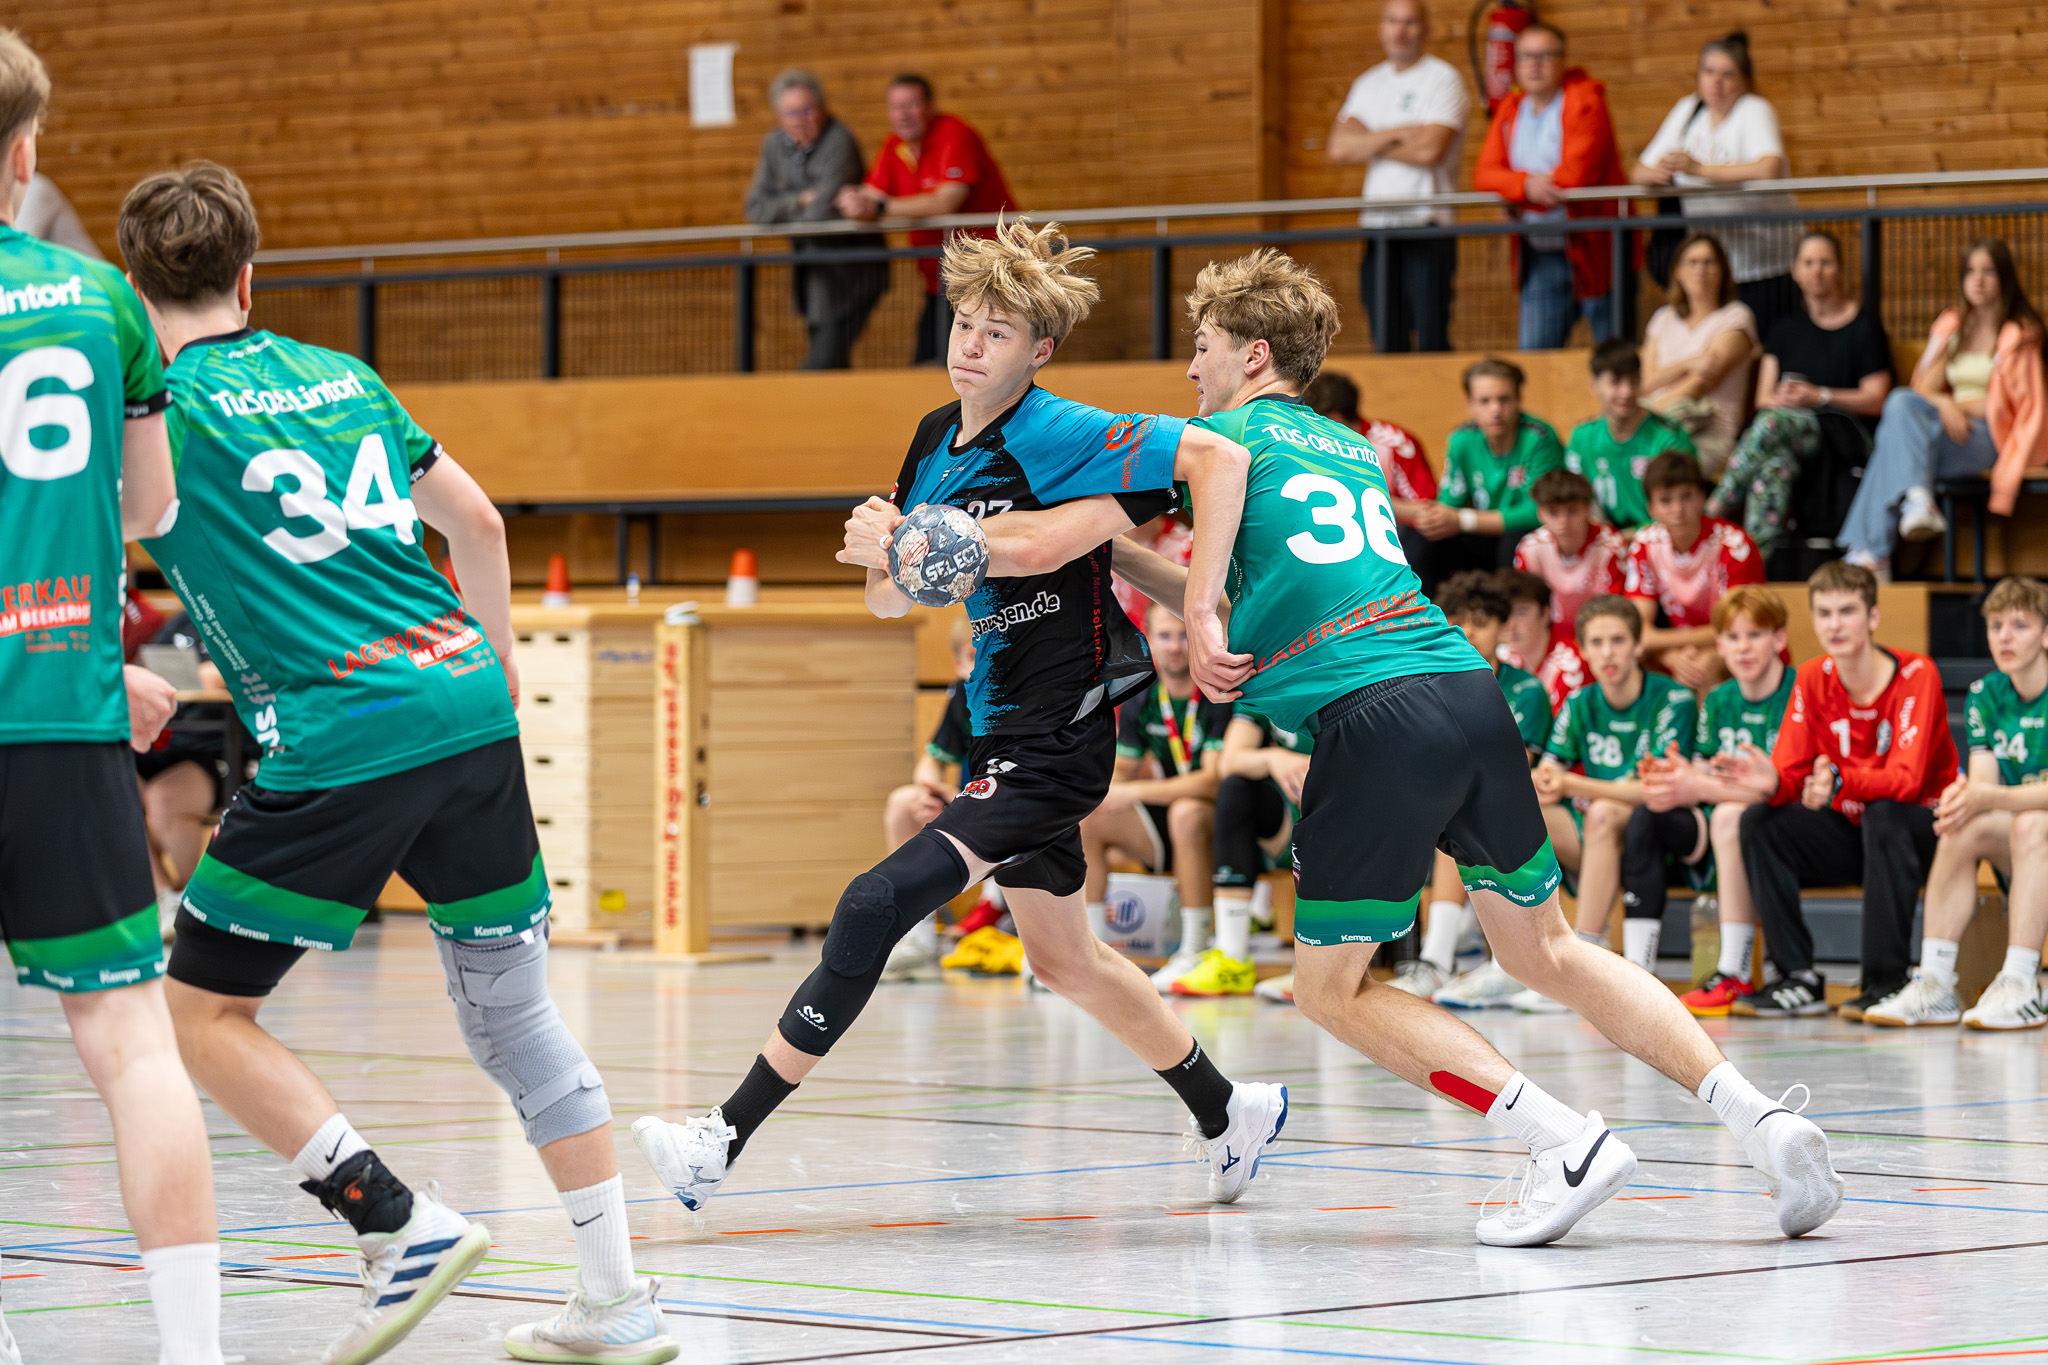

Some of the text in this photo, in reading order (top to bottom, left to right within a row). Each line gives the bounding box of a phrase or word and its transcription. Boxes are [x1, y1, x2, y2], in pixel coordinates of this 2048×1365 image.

[1261, 425, 1381, 468] TuS 08 Linto
[241, 433, 418, 564] 34
[1280, 473, 1409, 566] 36
[925, 543, 981, 583] SELECT
[1257, 590, 1418, 673] LAGERVERKAUF
[1586, 731, 1624, 768] 28
[1829, 718, 1850, 759] 1
[1993, 729, 2029, 764] 24
[229, 922, 270, 942] Kempa
[293, 935, 334, 951] Kempa
[473, 924, 514, 938] Kempa
[1340, 934, 1373, 944] Kempa
[1391, 920, 1416, 939] Kemp
